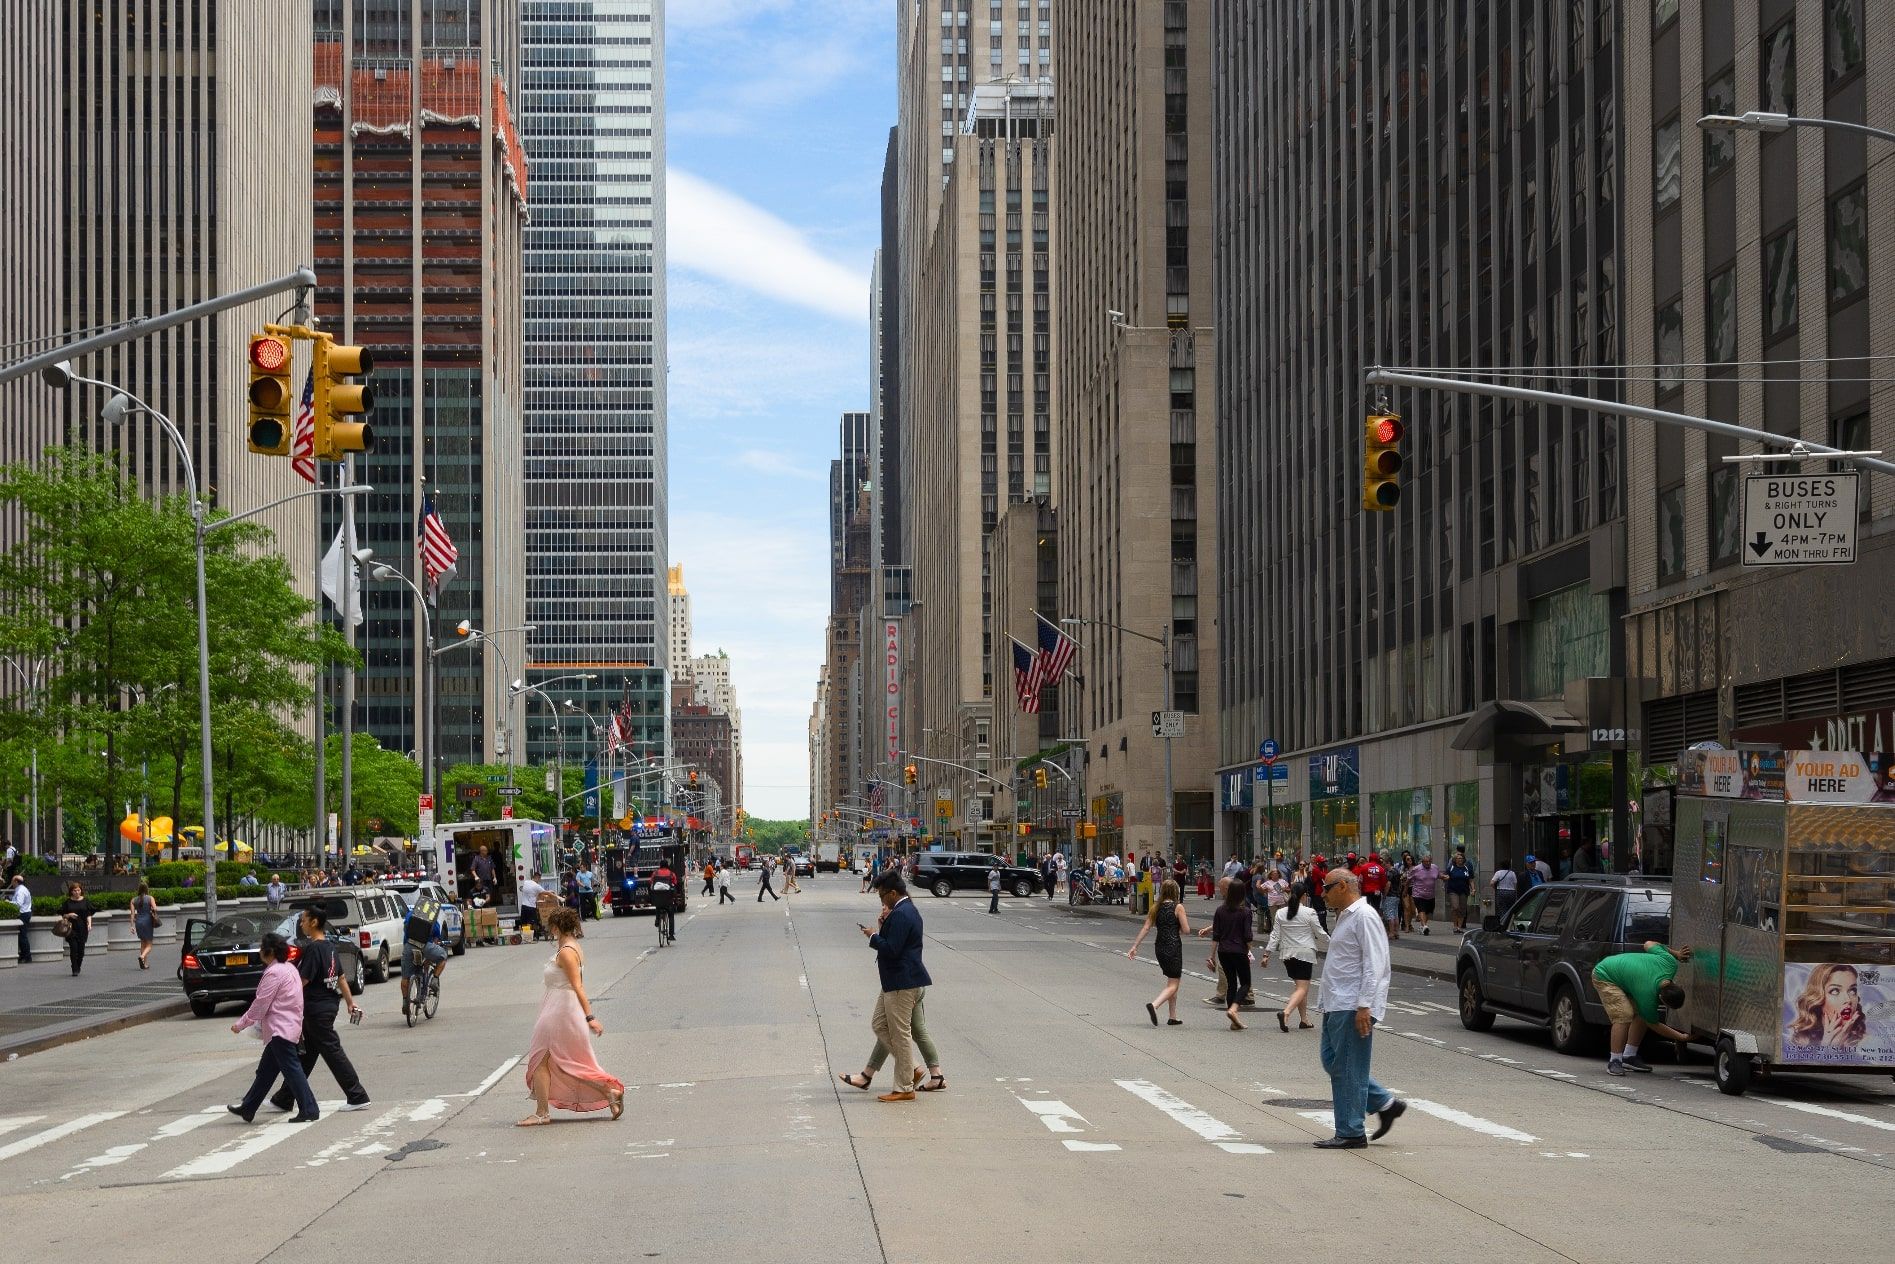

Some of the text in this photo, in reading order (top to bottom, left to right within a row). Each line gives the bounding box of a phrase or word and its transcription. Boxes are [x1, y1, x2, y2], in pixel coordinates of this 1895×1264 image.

[1768, 480, 1835, 498] BUSES
[1765, 500, 1838, 510] & RIGHT TURNS
[1773, 512, 1828, 529] ONLY
[1774, 547, 1851, 559] MON THRU FRI
[887, 625, 898, 694] RADIO
[887, 707, 898, 762] CITY
[1592, 729, 1625, 742] 1212
[1709, 756, 1726, 774] YOUR
[1727, 756, 1738, 774] AD
[1795, 763, 1831, 778] YOUR
[1839, 763, 1860, 778] AD
[1713, 775, 1732, 793] HERE
[1808, 779, 1846, 793] HERE
[970, 807, 981, 815] 25
